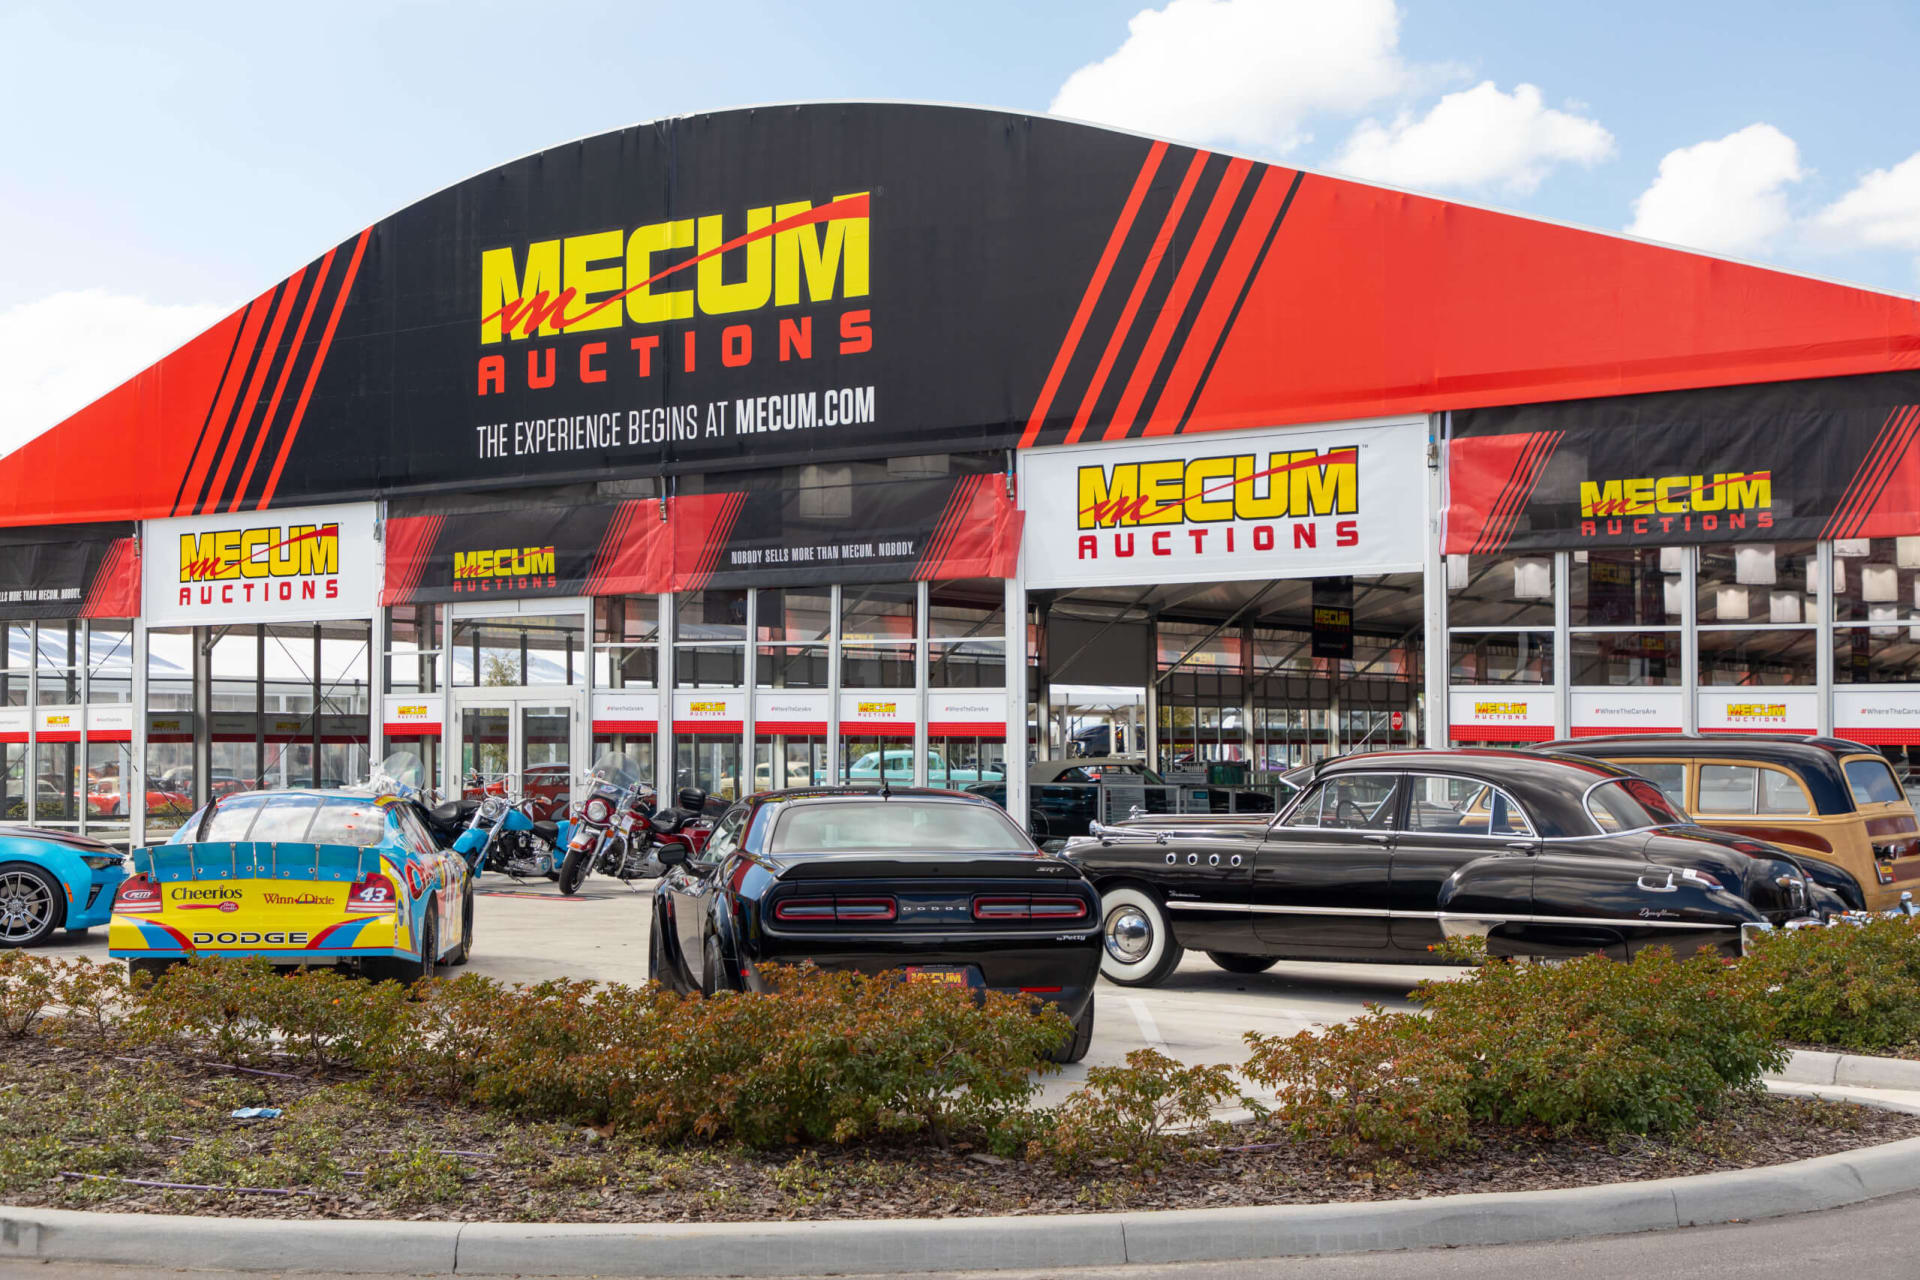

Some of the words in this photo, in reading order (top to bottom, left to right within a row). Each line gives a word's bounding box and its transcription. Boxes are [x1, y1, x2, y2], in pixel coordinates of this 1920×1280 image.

[480, 191, 870, 345] MECUM
[477, 309, 873, 396] AUCTIONS
[476, 423, 508, 459] THE
[515, 412, 621, 455] EXPERIENCE
[628, 404, 698, 444] BEGINS
[705, 401, 729, 438] AT
[735, 385, 875, 434] MECUM.COM
[1077, 445, 1359, 531] MECUM
[1580, 470, 1771, 518] MECUM
[1581, 512, 1774, 536] AUCTIONS
[1078, 520, 1359, 560] AUCTIONS
[179, 522, 339, 583] MECUM
[453, 545, 556, 579] MECUM
[731, 550, 762, 565] NOBODY
[765, 548, 789, 563] SELLS
[792, 547, 814, 562] MORE
[816, 546, 839, 561] THAN
[878, 541, 915, 557] NOBODY.
[8, 590, 22, 601] MORE
[23, 590, 37, 600] THAN
[179, 579, 338, 606] AUCTIONS
[453, 575, 557, 593] AUCTIONS
[857, 702, 897, 713] MECUM
[1475, 702, 1528, 714] MECUM
[1727, 703, 1786, 716] MECUM
[1860, 707, 1920, 715] #WhereTheCars
[171, 885, 243, 900] Cheerios
[360, 887, 387, 902] 43
[193, 932, 308, 945] DODGE
